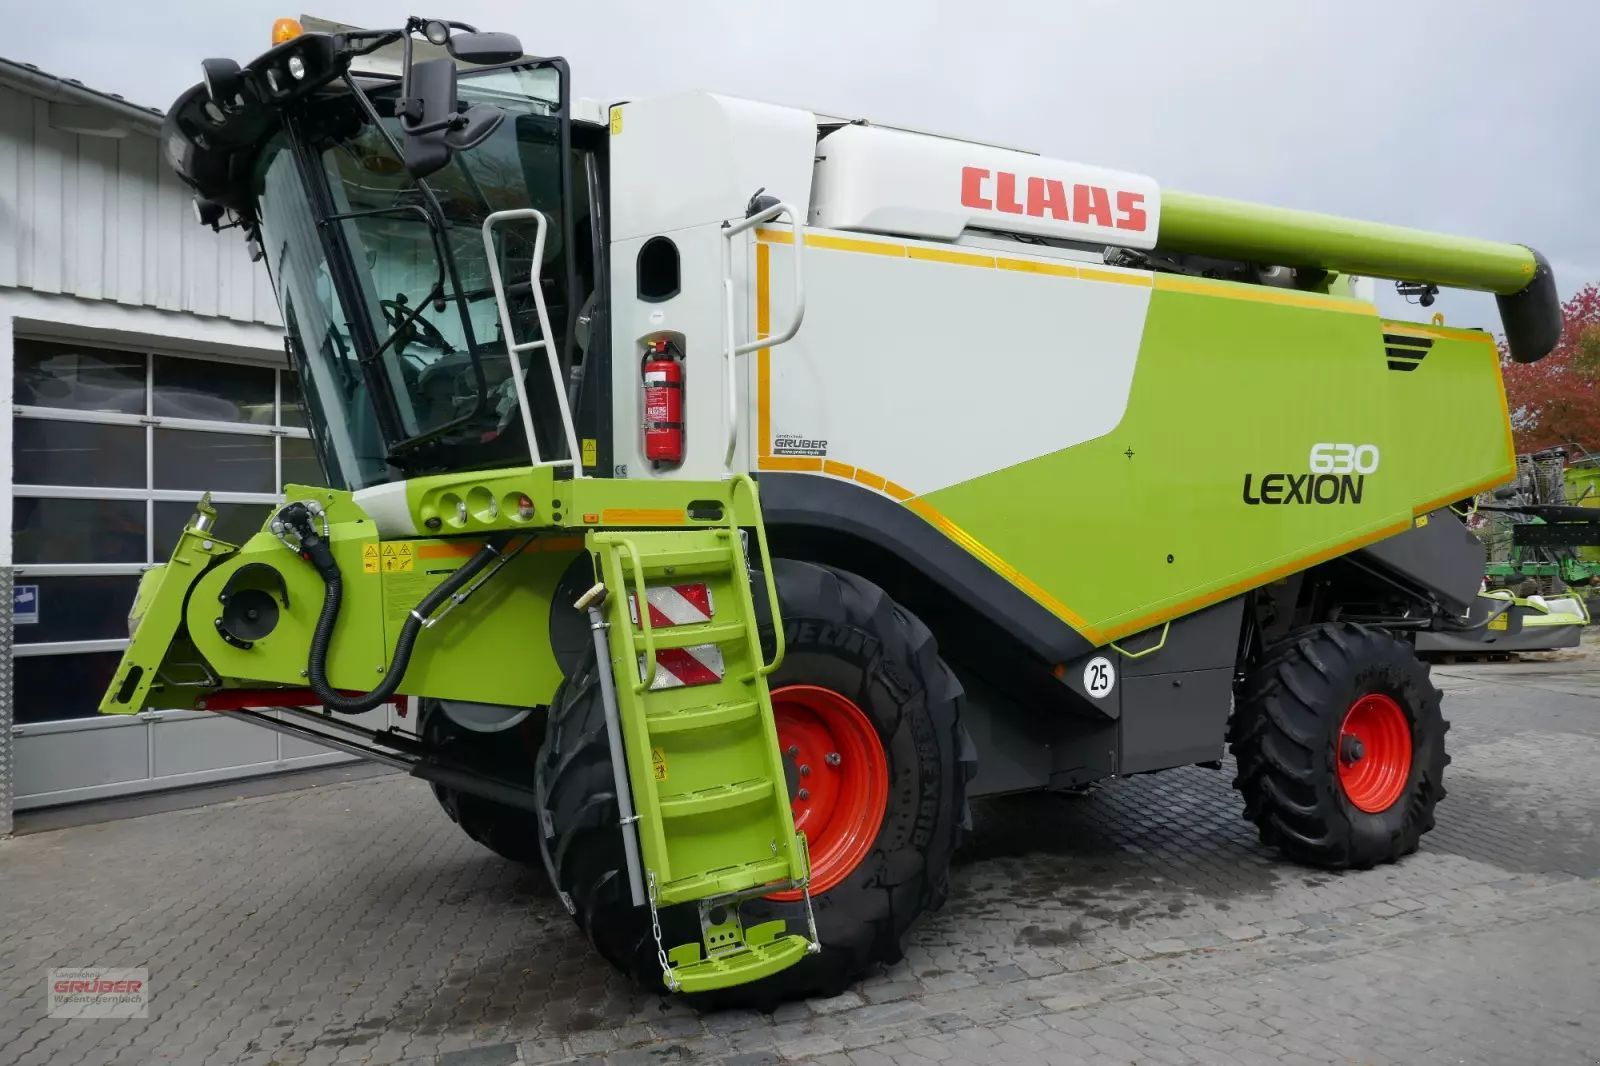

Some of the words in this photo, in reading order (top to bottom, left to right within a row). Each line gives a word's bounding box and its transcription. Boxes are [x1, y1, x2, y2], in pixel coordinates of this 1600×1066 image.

[960, 166, 1147, 232] CLAAS
[774, 438, 828, 449] GRUBER
[1309, 443, 1380, 475] 630
[1242, 473, 1364, 505] LEXION
[1090, 664, 1108, 691] 25
